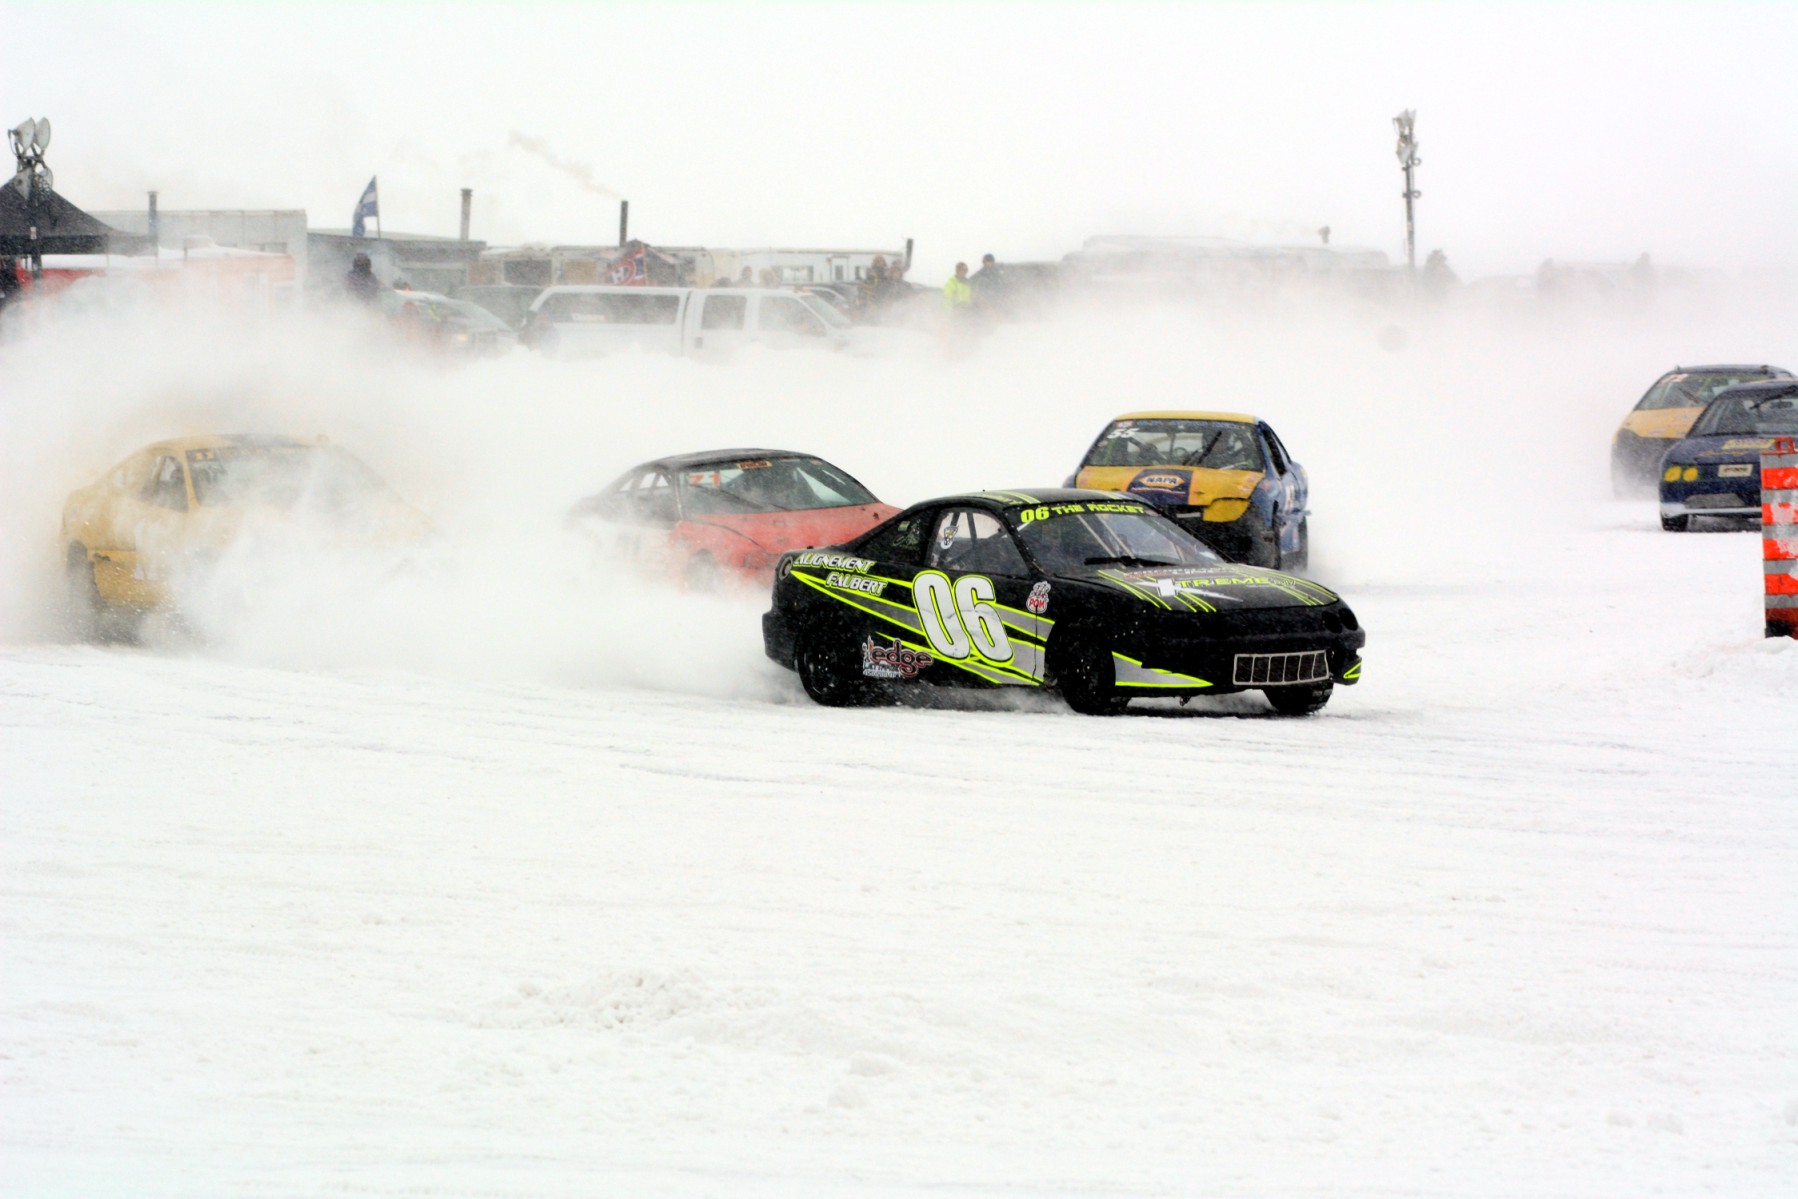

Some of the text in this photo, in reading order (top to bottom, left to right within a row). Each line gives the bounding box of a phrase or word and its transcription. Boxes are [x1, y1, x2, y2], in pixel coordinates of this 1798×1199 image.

[1145, 476, 1178, 485] NAPA
[1020, 503, 1145, 523] 06 THE ROCKET
[792, 552, 877, 575] ALIGNEMENT
[824, 571, 888, 597] FAUBERT
[911, 569, 1015, 667] 06
[869, 637, 934, 678] edge
